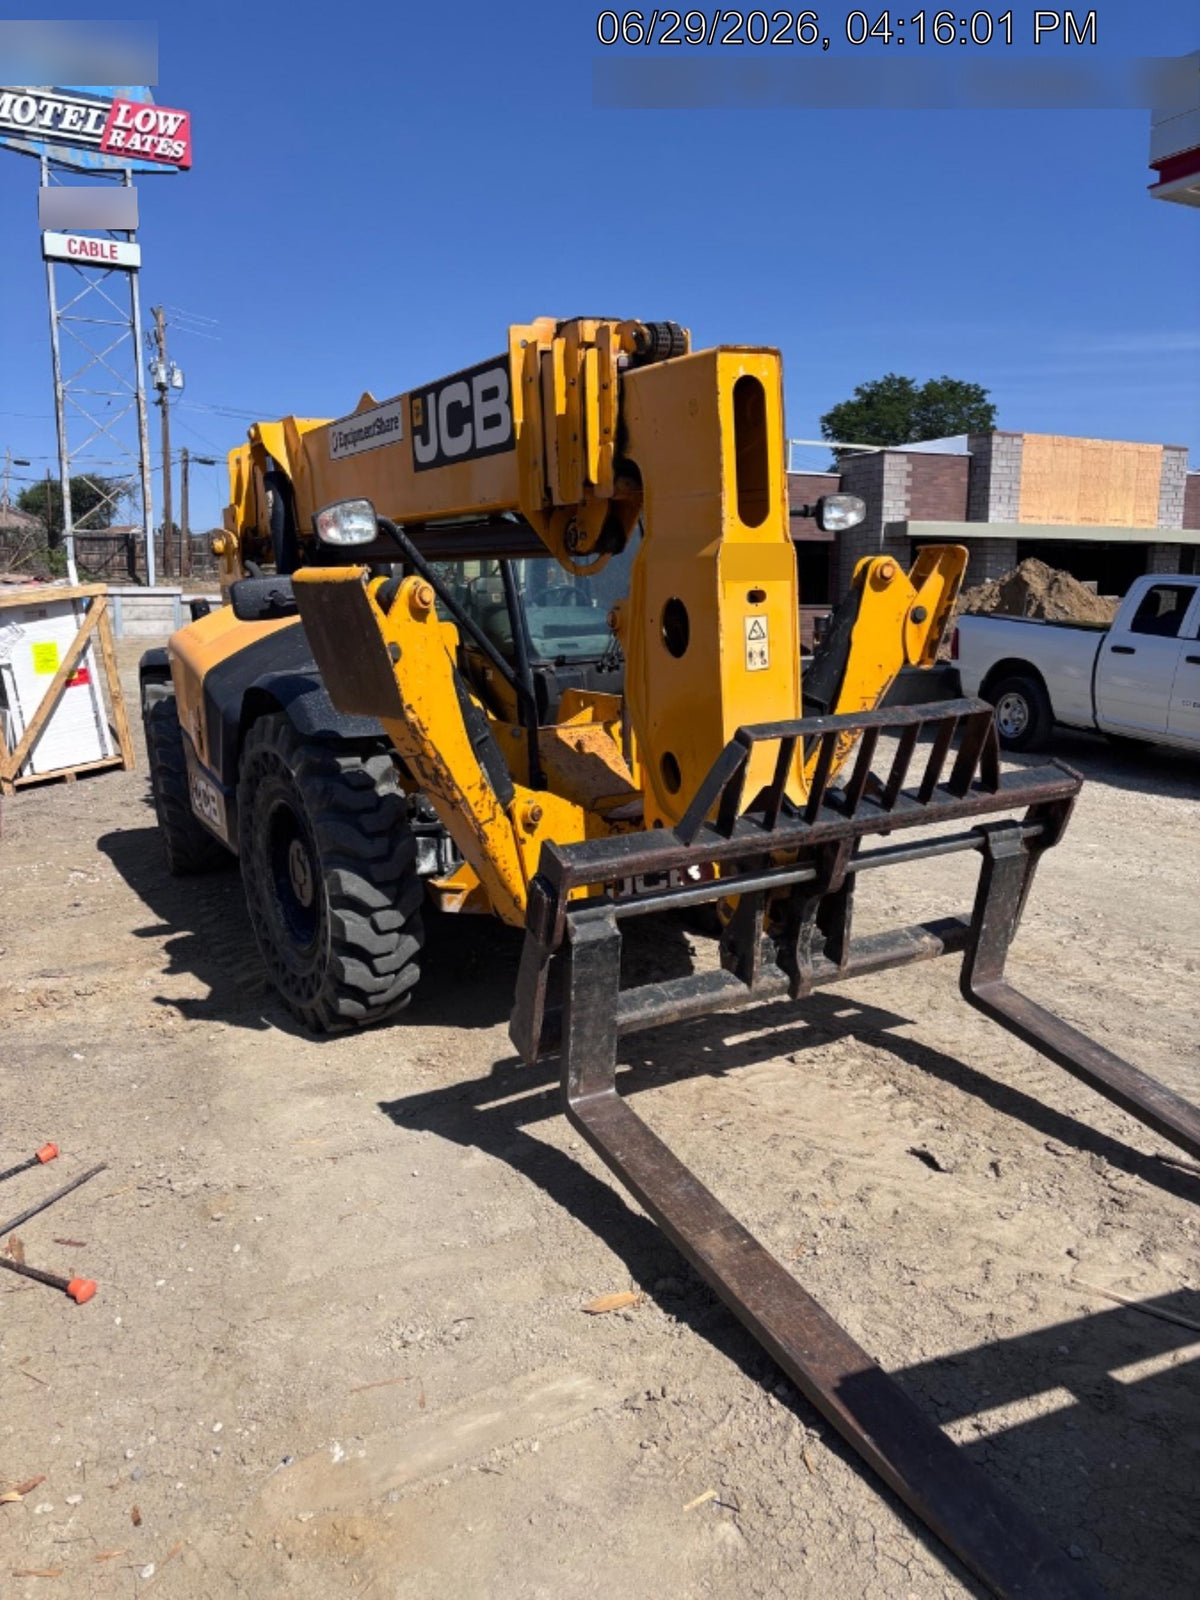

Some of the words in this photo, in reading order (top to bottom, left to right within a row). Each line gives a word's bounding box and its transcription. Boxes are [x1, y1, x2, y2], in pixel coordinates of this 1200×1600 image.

[114, 104, 186, 136] LOW
[107, 129, 187, 158] RATES
[67, 238, 118, 260] CABLE
[414, 367, 511, 463] JCB
